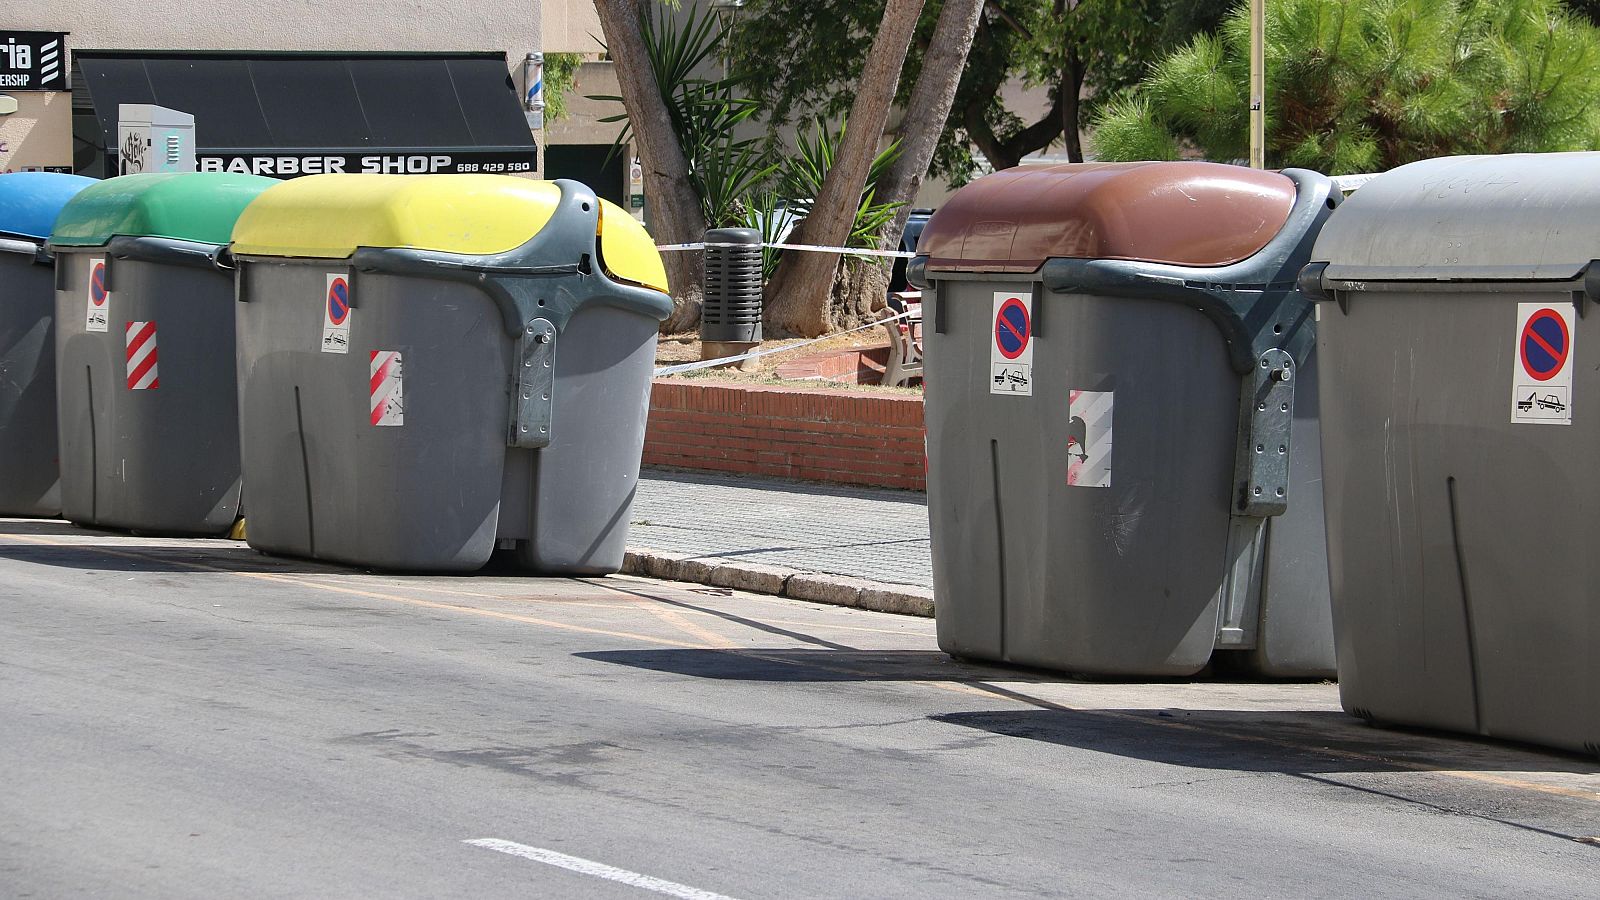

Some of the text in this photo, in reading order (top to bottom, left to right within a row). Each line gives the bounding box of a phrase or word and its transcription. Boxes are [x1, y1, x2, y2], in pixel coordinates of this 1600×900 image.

[200, 155, 530, 175] BARBER SHOP 688 429 580
